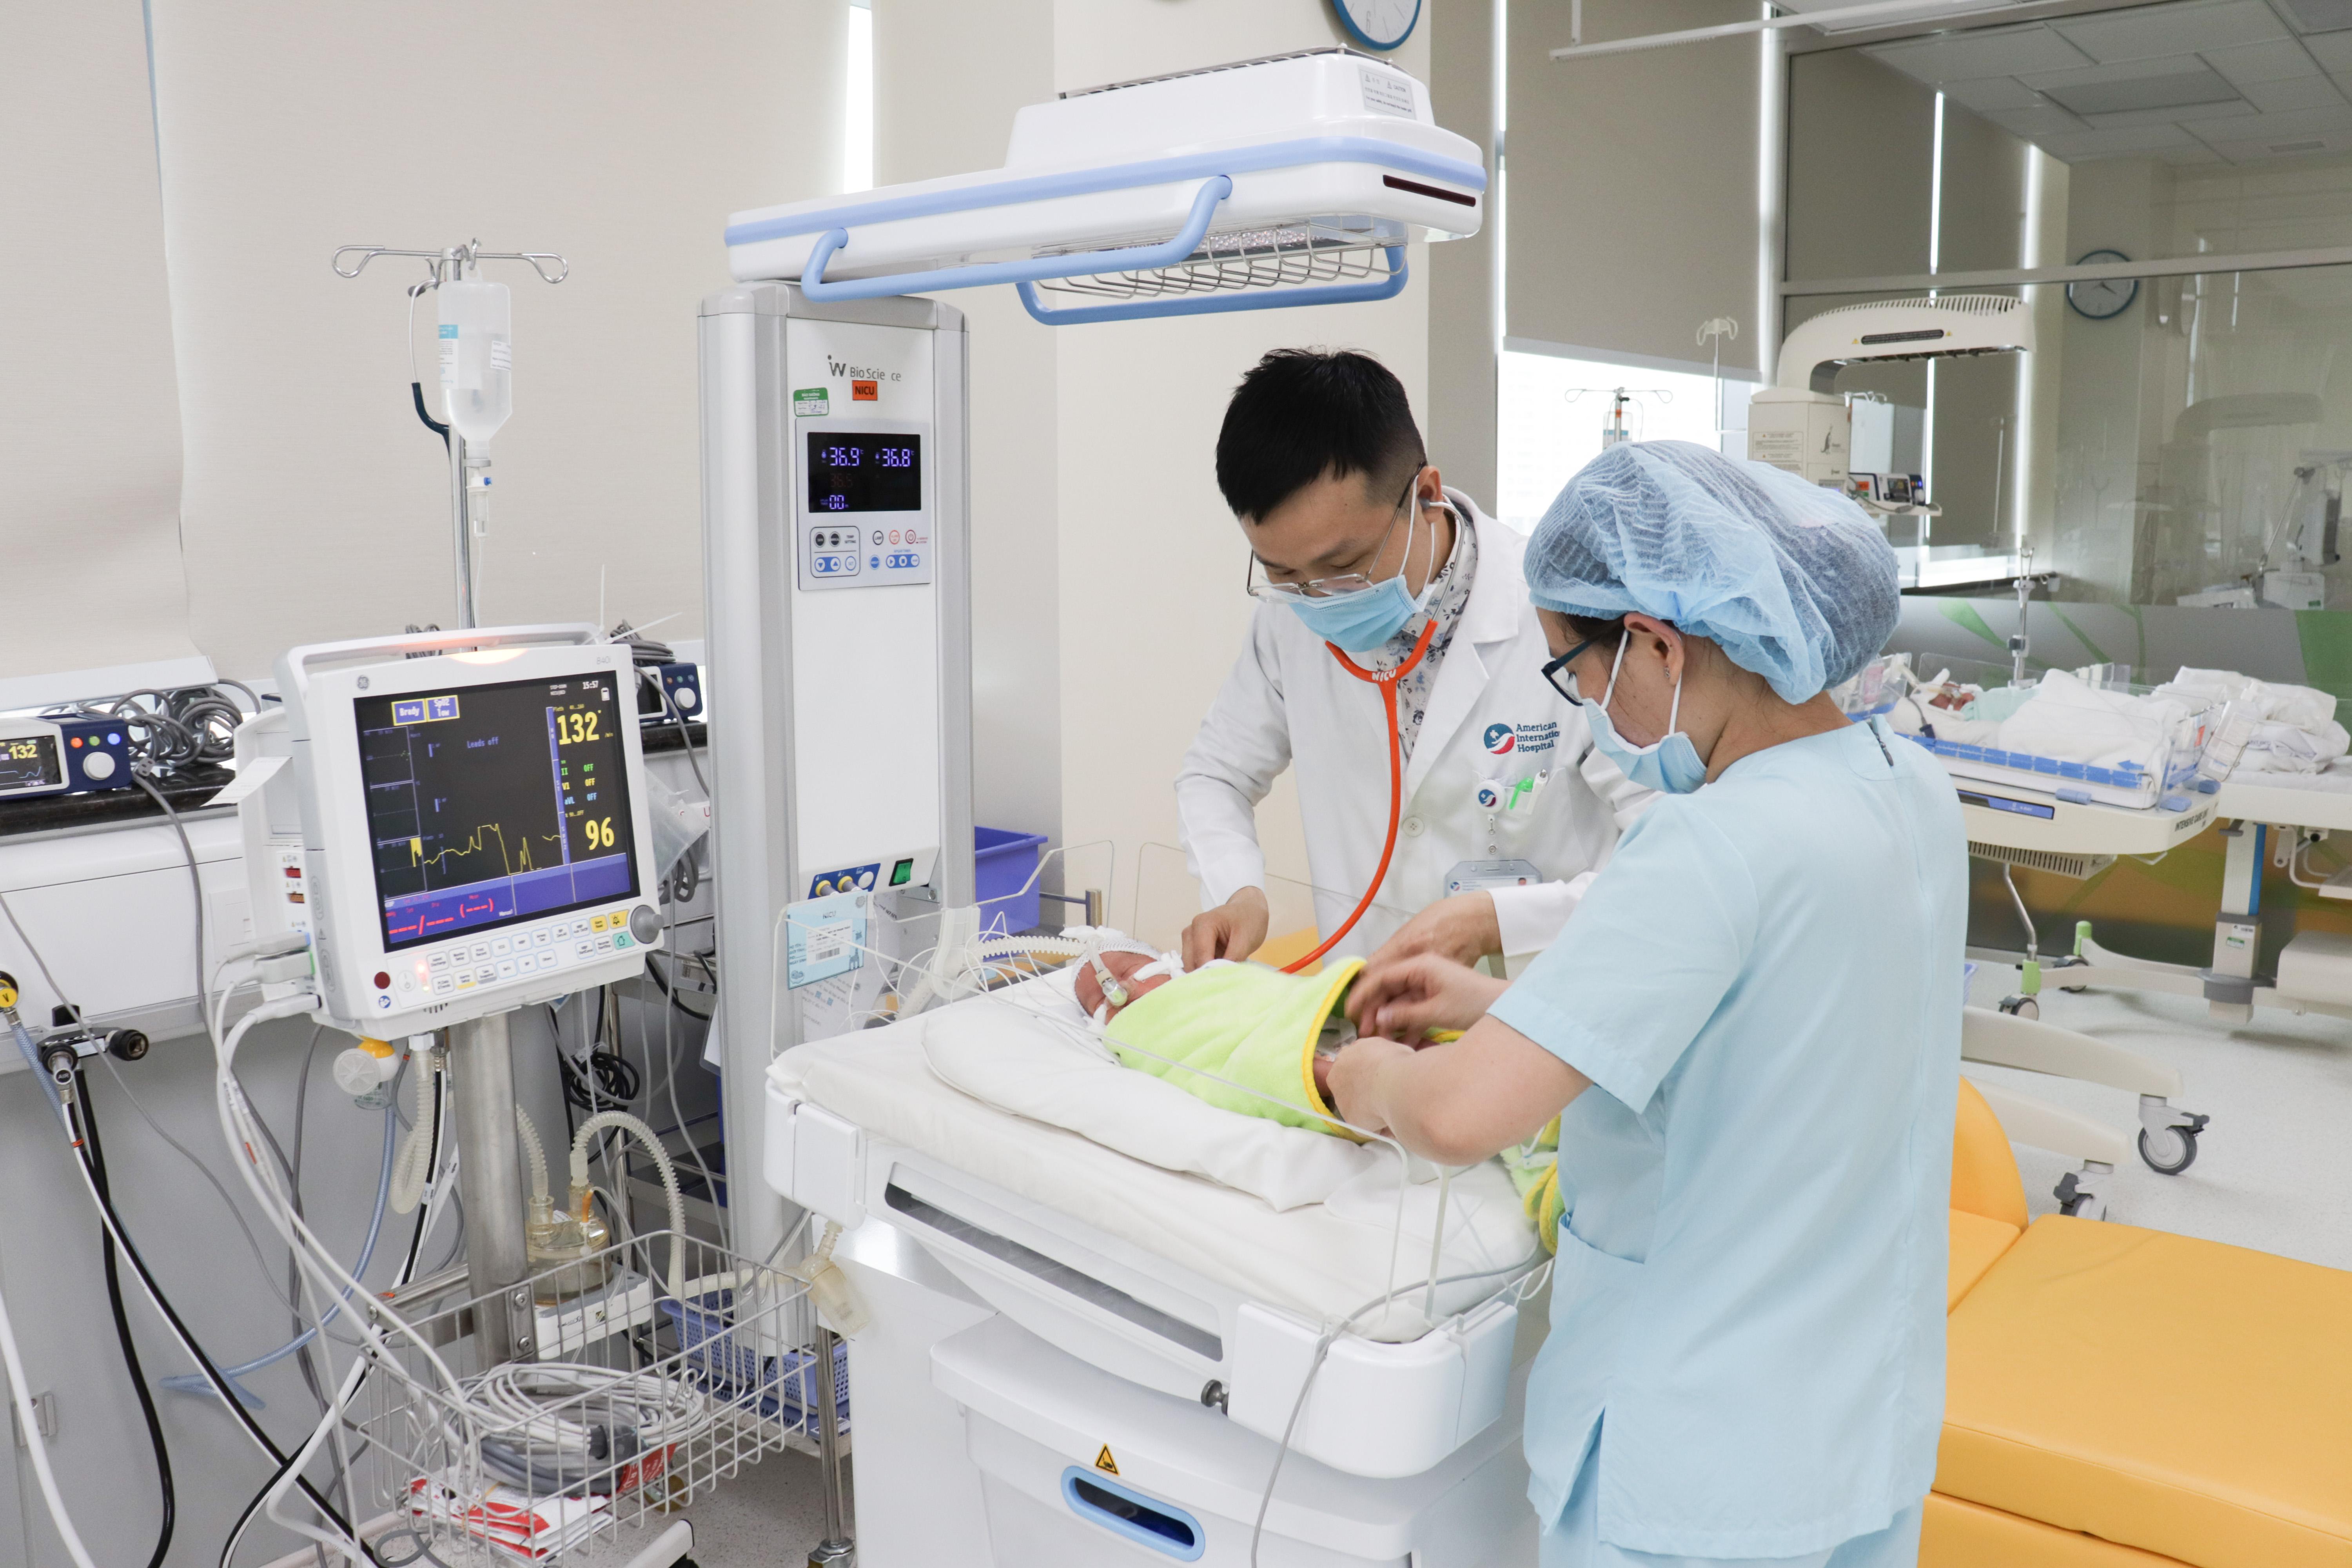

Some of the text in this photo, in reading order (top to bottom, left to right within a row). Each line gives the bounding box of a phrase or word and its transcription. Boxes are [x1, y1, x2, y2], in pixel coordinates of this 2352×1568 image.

[855, 386, 875, 396] NICU
[829, 447, 859, 466] 36.9
[882, 448, 910, 467] 36.8
[583, 681, 599, 690] 15:57
[399, 706, 420, 717] Brady
[557, 711, 600, 745] 132
[1516, 722, 1557, 732] American
[466, 737, 499, 748] Leads off
[1517, 739, 1555, 753] Hospital
[9, 744, 38, 759] 132
[583, 764, 594, 772] OFF
[585, 778, 595, 787] OFF
[587, 793, 597, 801] OFF
[2174, 816, 2195, 831] INTENSIVE
[585, 817, 615, 850] 96
[823, 911, 836, 919] NICU
